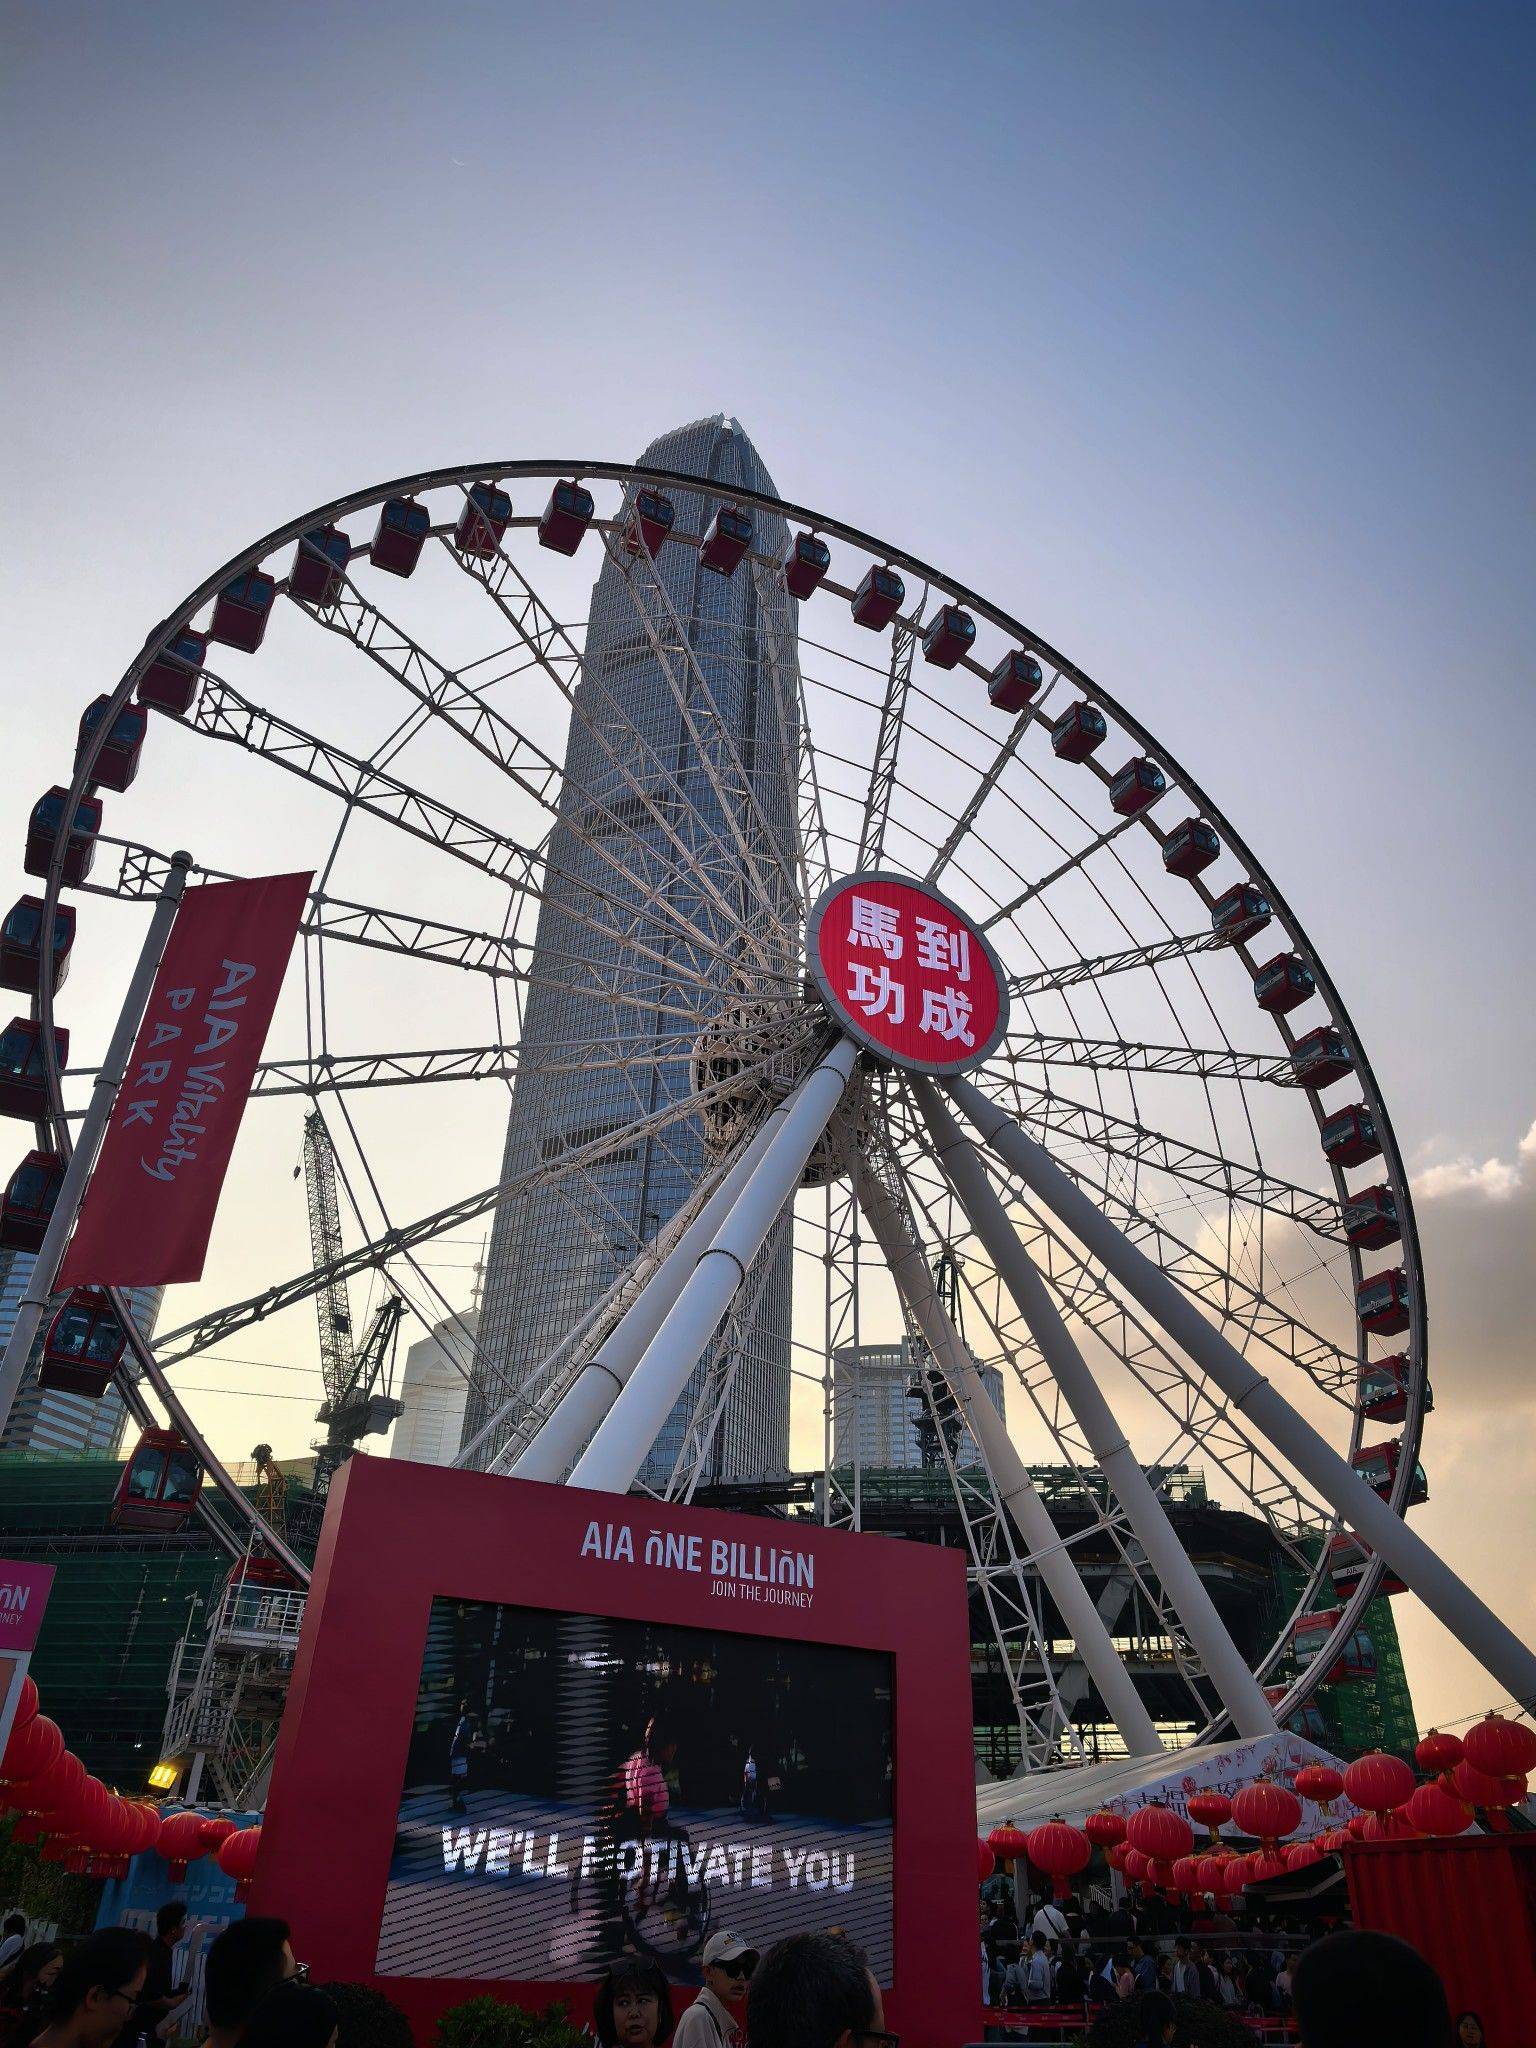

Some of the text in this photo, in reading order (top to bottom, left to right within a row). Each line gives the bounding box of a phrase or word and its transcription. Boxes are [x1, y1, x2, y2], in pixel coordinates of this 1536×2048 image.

[847, 895, 971, 982] 馬到
[847, 961, 975, 1047] 功成
[122, 988, 195, 1128] PARK
[141, 958, 256, 1181] AIA Vitality
[580, 1521, 634, 1563] AIA
[711, 1581, 814, 1609] JOIN THE JOURNEY
[442, 1825, 569, 1878] WE'LL
[783, 1846, 855, 1893] YOU
